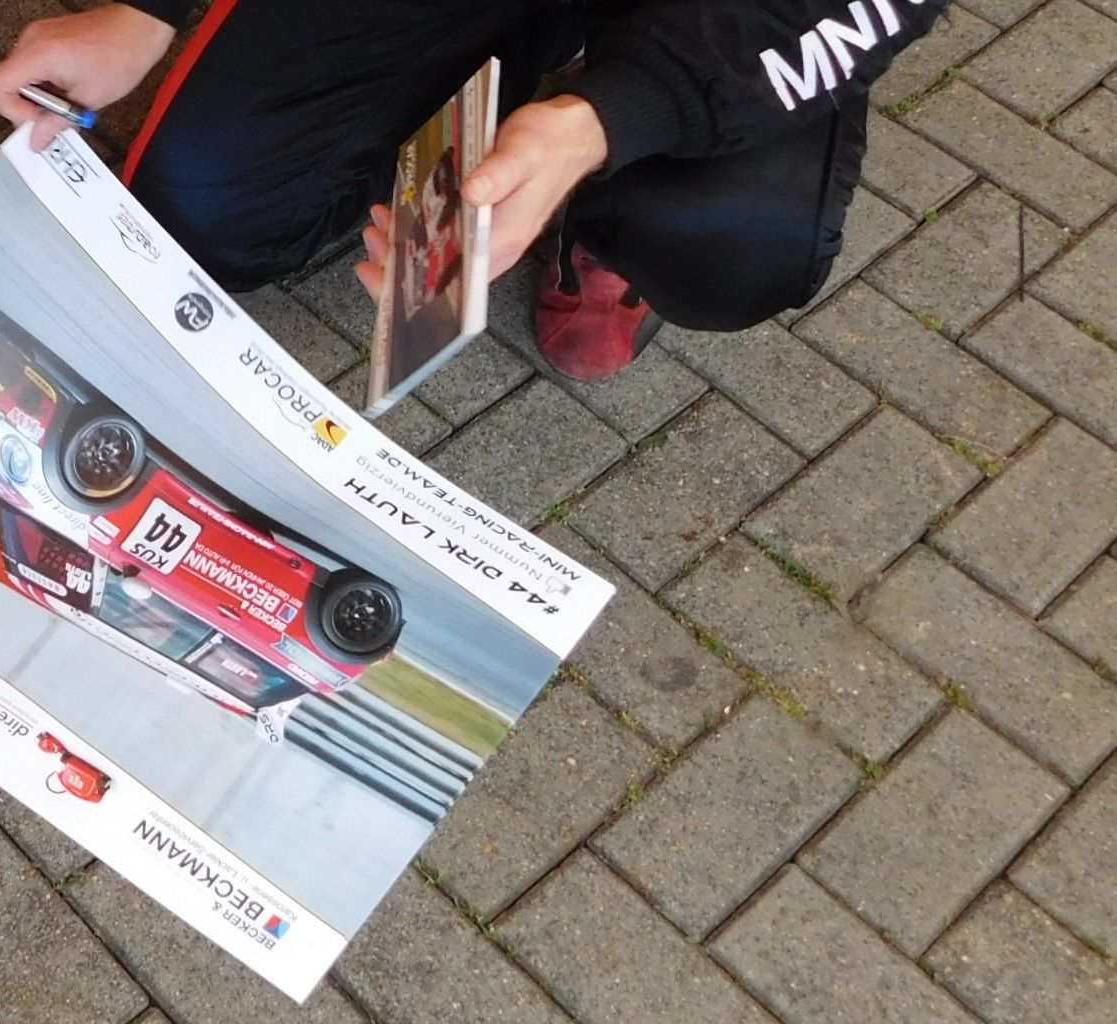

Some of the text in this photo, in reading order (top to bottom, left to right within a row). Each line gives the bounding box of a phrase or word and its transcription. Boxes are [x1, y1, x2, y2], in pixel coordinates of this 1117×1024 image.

[237, 348, 322, 423] PROCAR
[310, 432, 334, 453] ADAC
[143, 511, 187, 553] 44
[343, 476, 560, 617] #44 DIRK LAUTH
[354, 454, 543, 580] Nummer Vierundvierzig
[375, 447, 581, 581] MINI-RACING-TEAM.DE
[181, 547, 281, 612] BECKMANN
[246, 603, 287, 632] BECKER
[132, 818, 264, 920] BECKMANN
[210, 900, 276, 949] BECKER &
